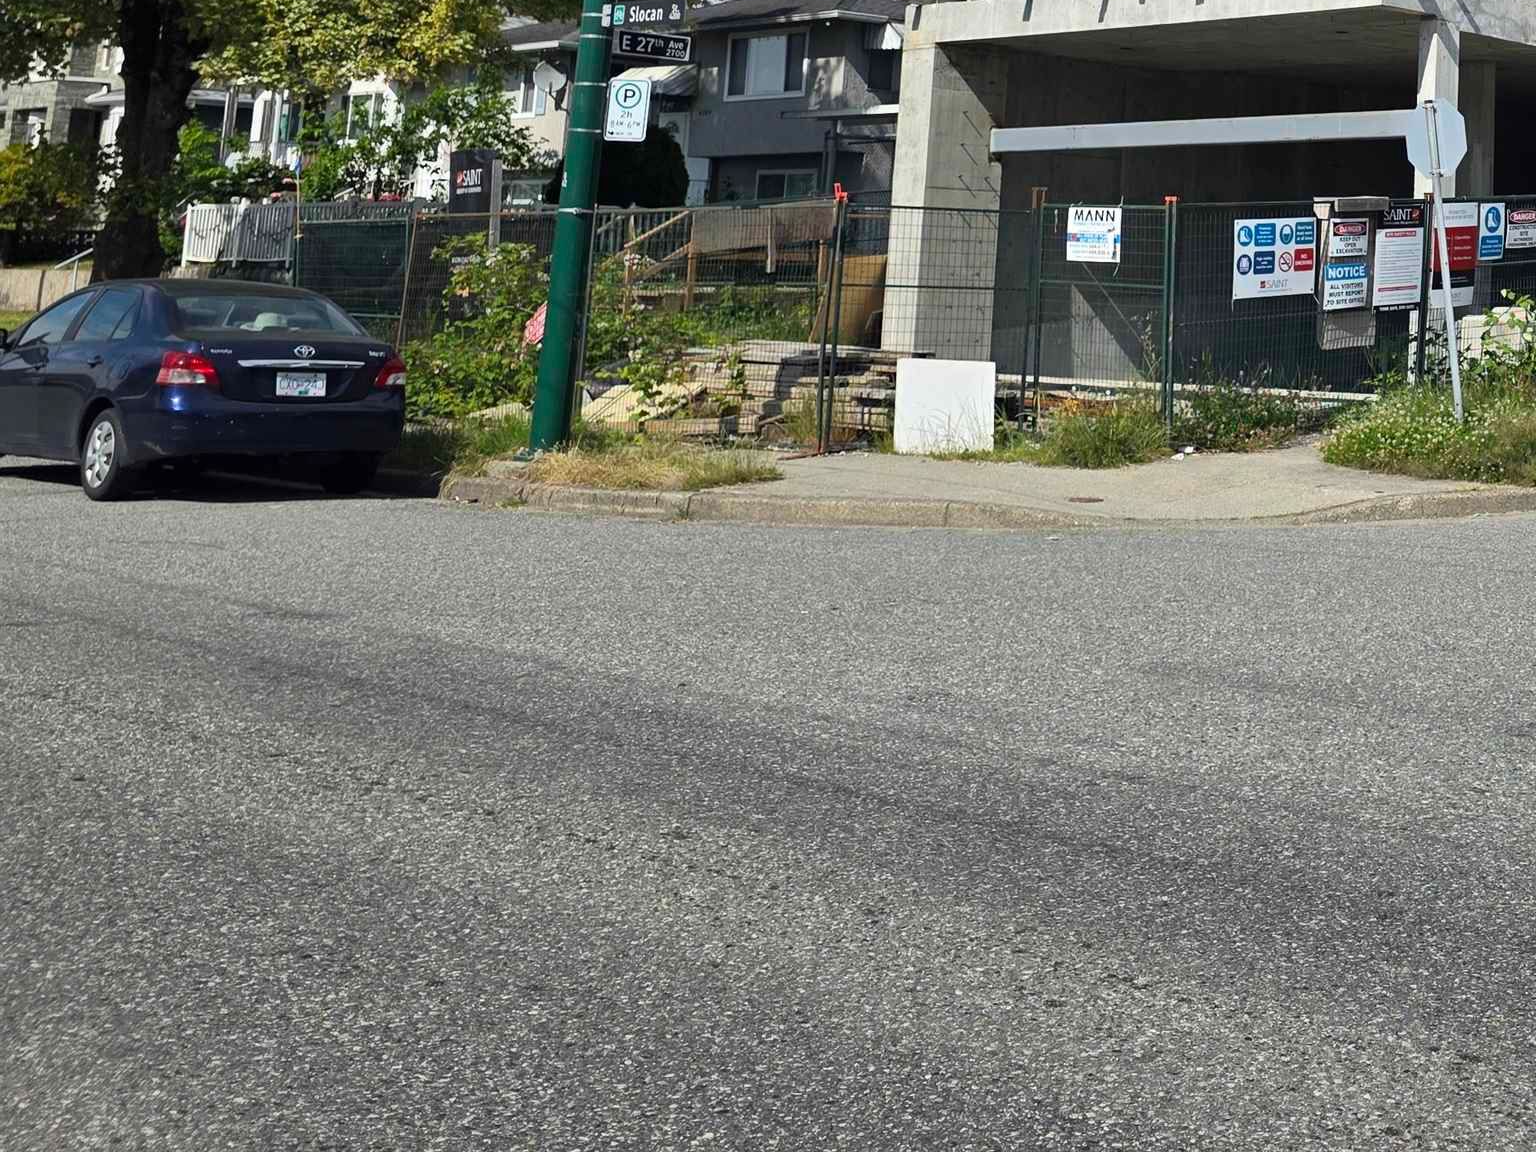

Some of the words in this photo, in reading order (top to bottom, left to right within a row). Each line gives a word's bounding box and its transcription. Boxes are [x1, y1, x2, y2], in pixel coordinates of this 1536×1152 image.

[629, 5, 663, 22] Slocan
[622, 35, 632, 50] E
[636, 37, 664, 52] 27th
[668, 40, 685, 49] Ave
[665, 49, 686, 58] 2700
[624, 89, 636, 103] P
[463, 168, 483, 186] SAINT
[1074, 209, 1116, 222] MANN
[1384, 208, 1412, 221] SAINT
[1514, 212, 1536, 221] DANGER
[1328, 266, 1366, 278] NOTICE
[1267, 280, 1288, 288] SAINT
